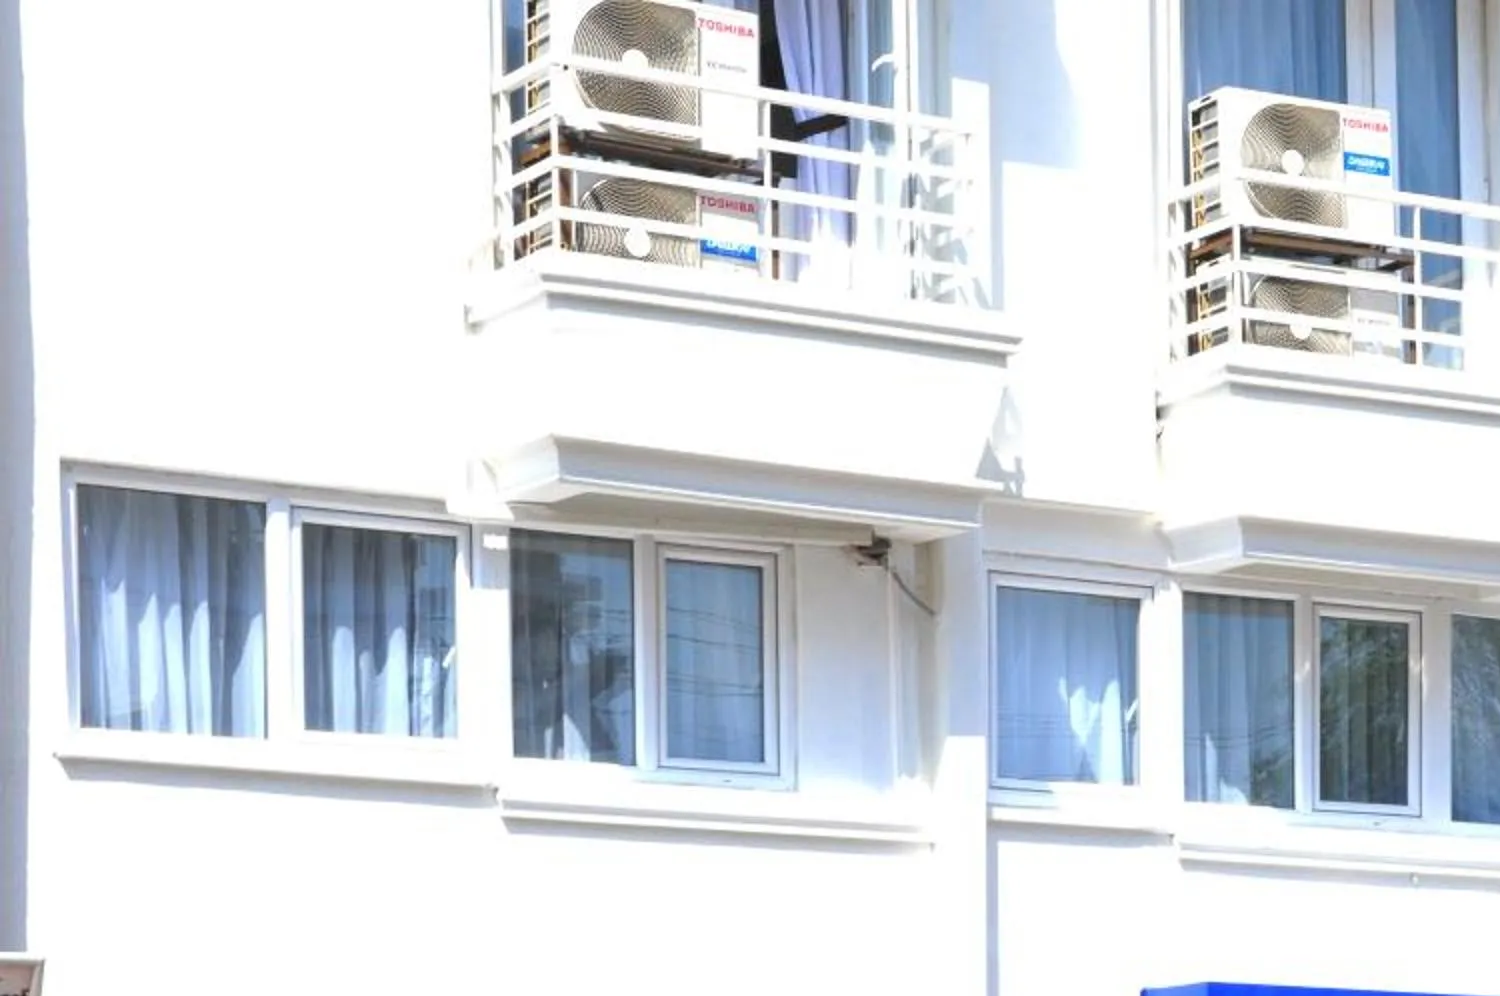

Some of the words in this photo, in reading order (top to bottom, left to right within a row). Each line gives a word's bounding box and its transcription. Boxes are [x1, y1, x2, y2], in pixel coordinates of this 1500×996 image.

[698, 18, 755, 38] TOSHIBA
[1342, 118, 1388, 133] TOSHIBA
[701, 195, 755, 213] TOSHIBA
